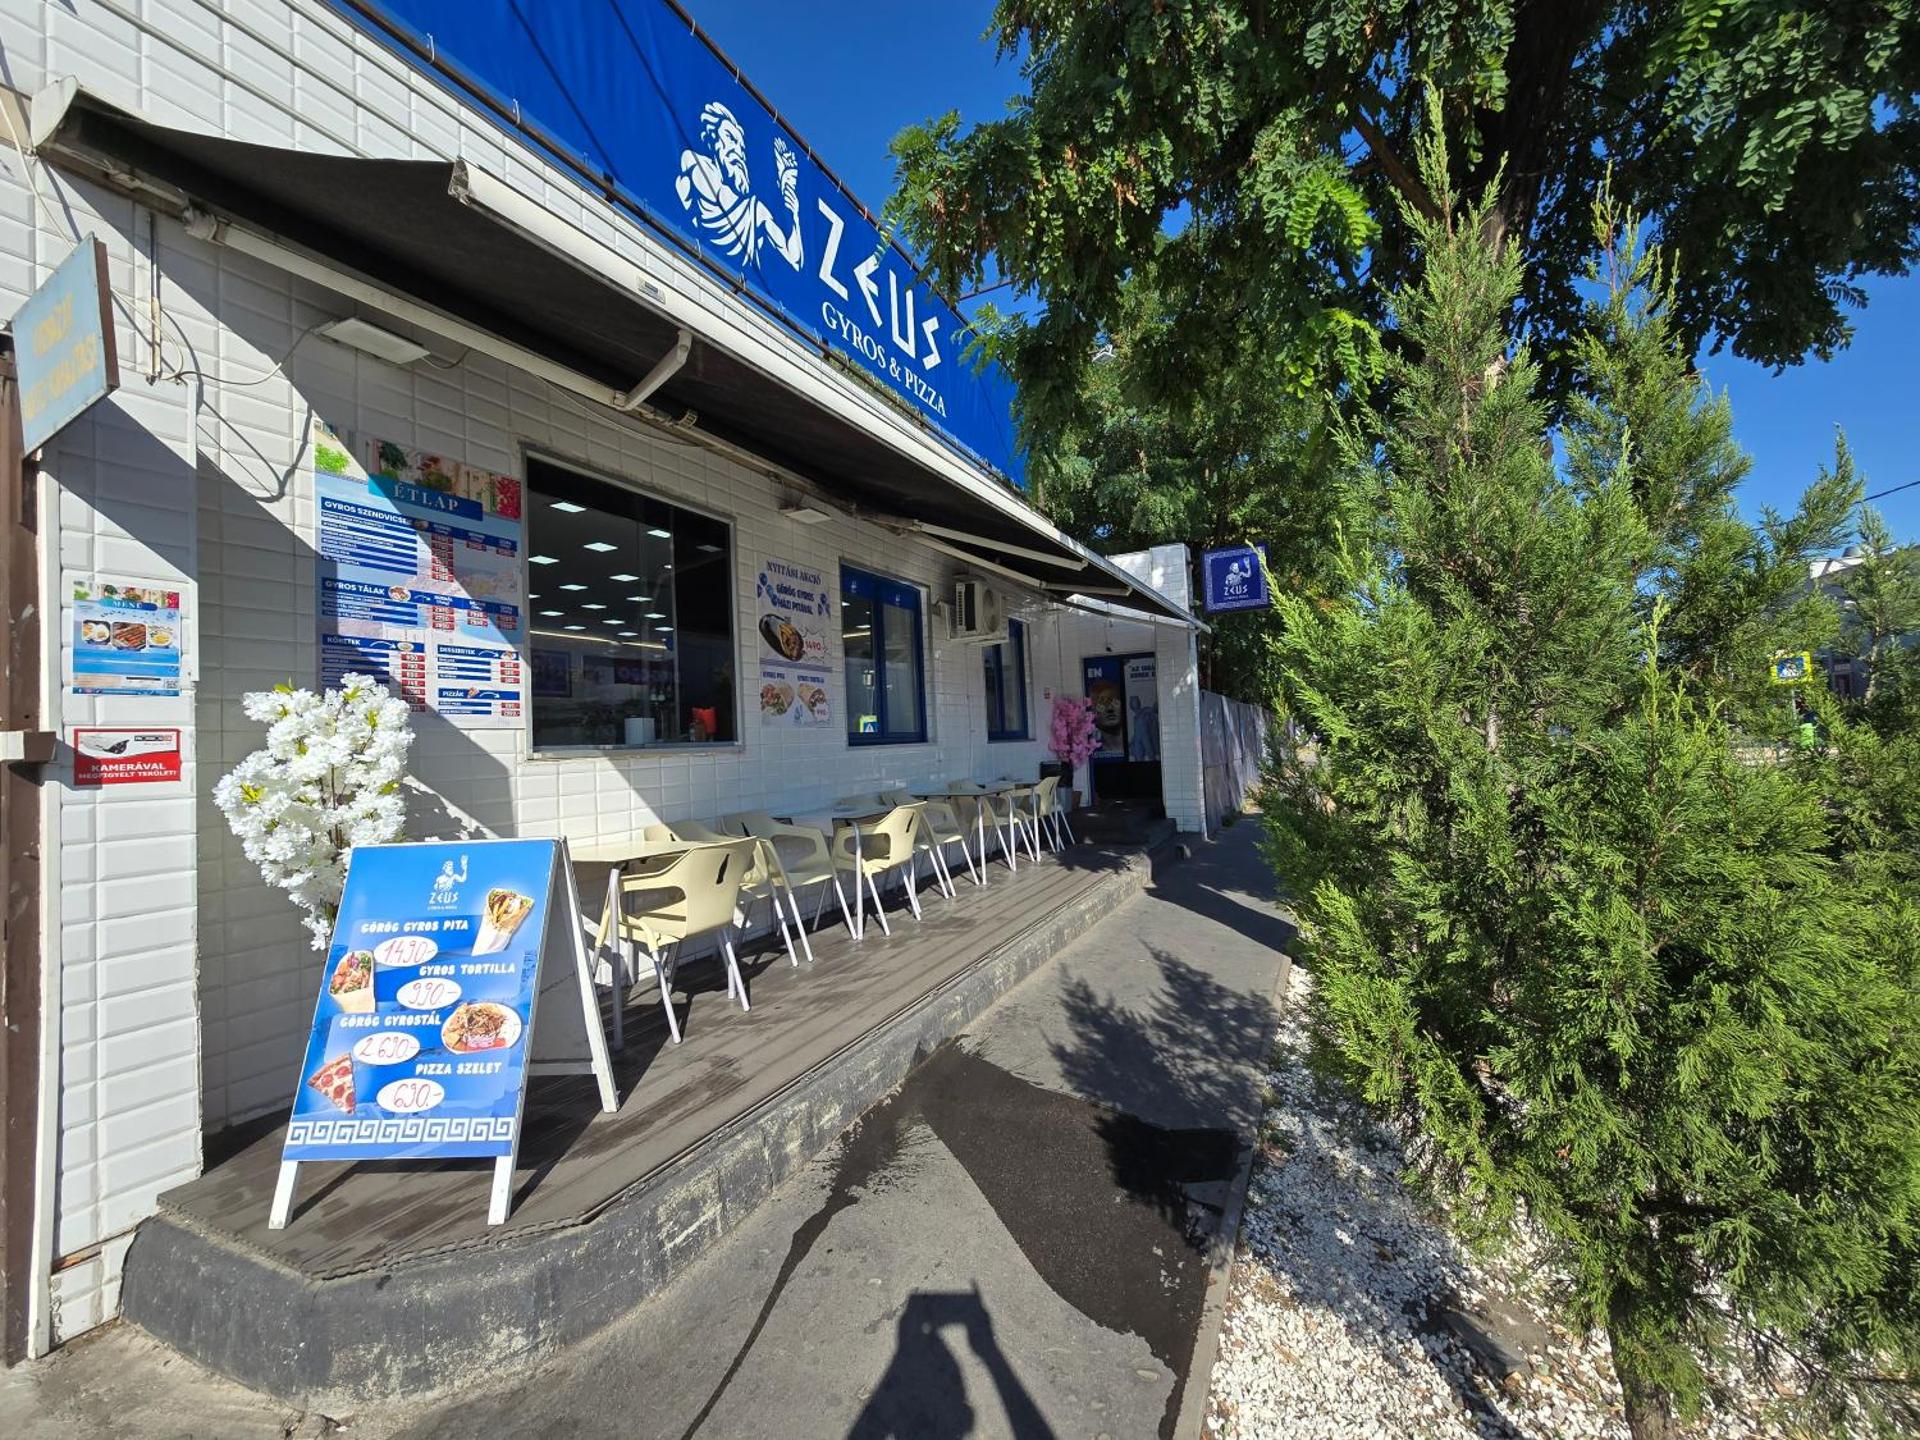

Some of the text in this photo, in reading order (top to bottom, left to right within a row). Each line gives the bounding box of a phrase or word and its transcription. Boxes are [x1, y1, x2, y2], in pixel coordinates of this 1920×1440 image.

[817, 197, 941, 370] ZEUS
[822, 302, 947, 418] GYROS & PIZZA
[324, 501, 356, 513] GYROS
[767, 560, 798, 579] NYITÁSI
[325, 580, 385, 595] GYROS TÁLAK
[1224, 584, 1248, 596] ZEUS
[92, 762, 166, 772] KAMERÁVAL
[79, 771, 136, 779] MEGFIGYELT
[429, 891, 459, 904] ZEUS
[361, 919, 469, 934] GÖRÖG GYROS PITA
[419, 962, 516, 976] GYROS TORTILLA
[340, 1010, 441, 1028] GÖRÖG GYROSTÁL
[416, 1062, 503, 1075] PIZZA SZELET
